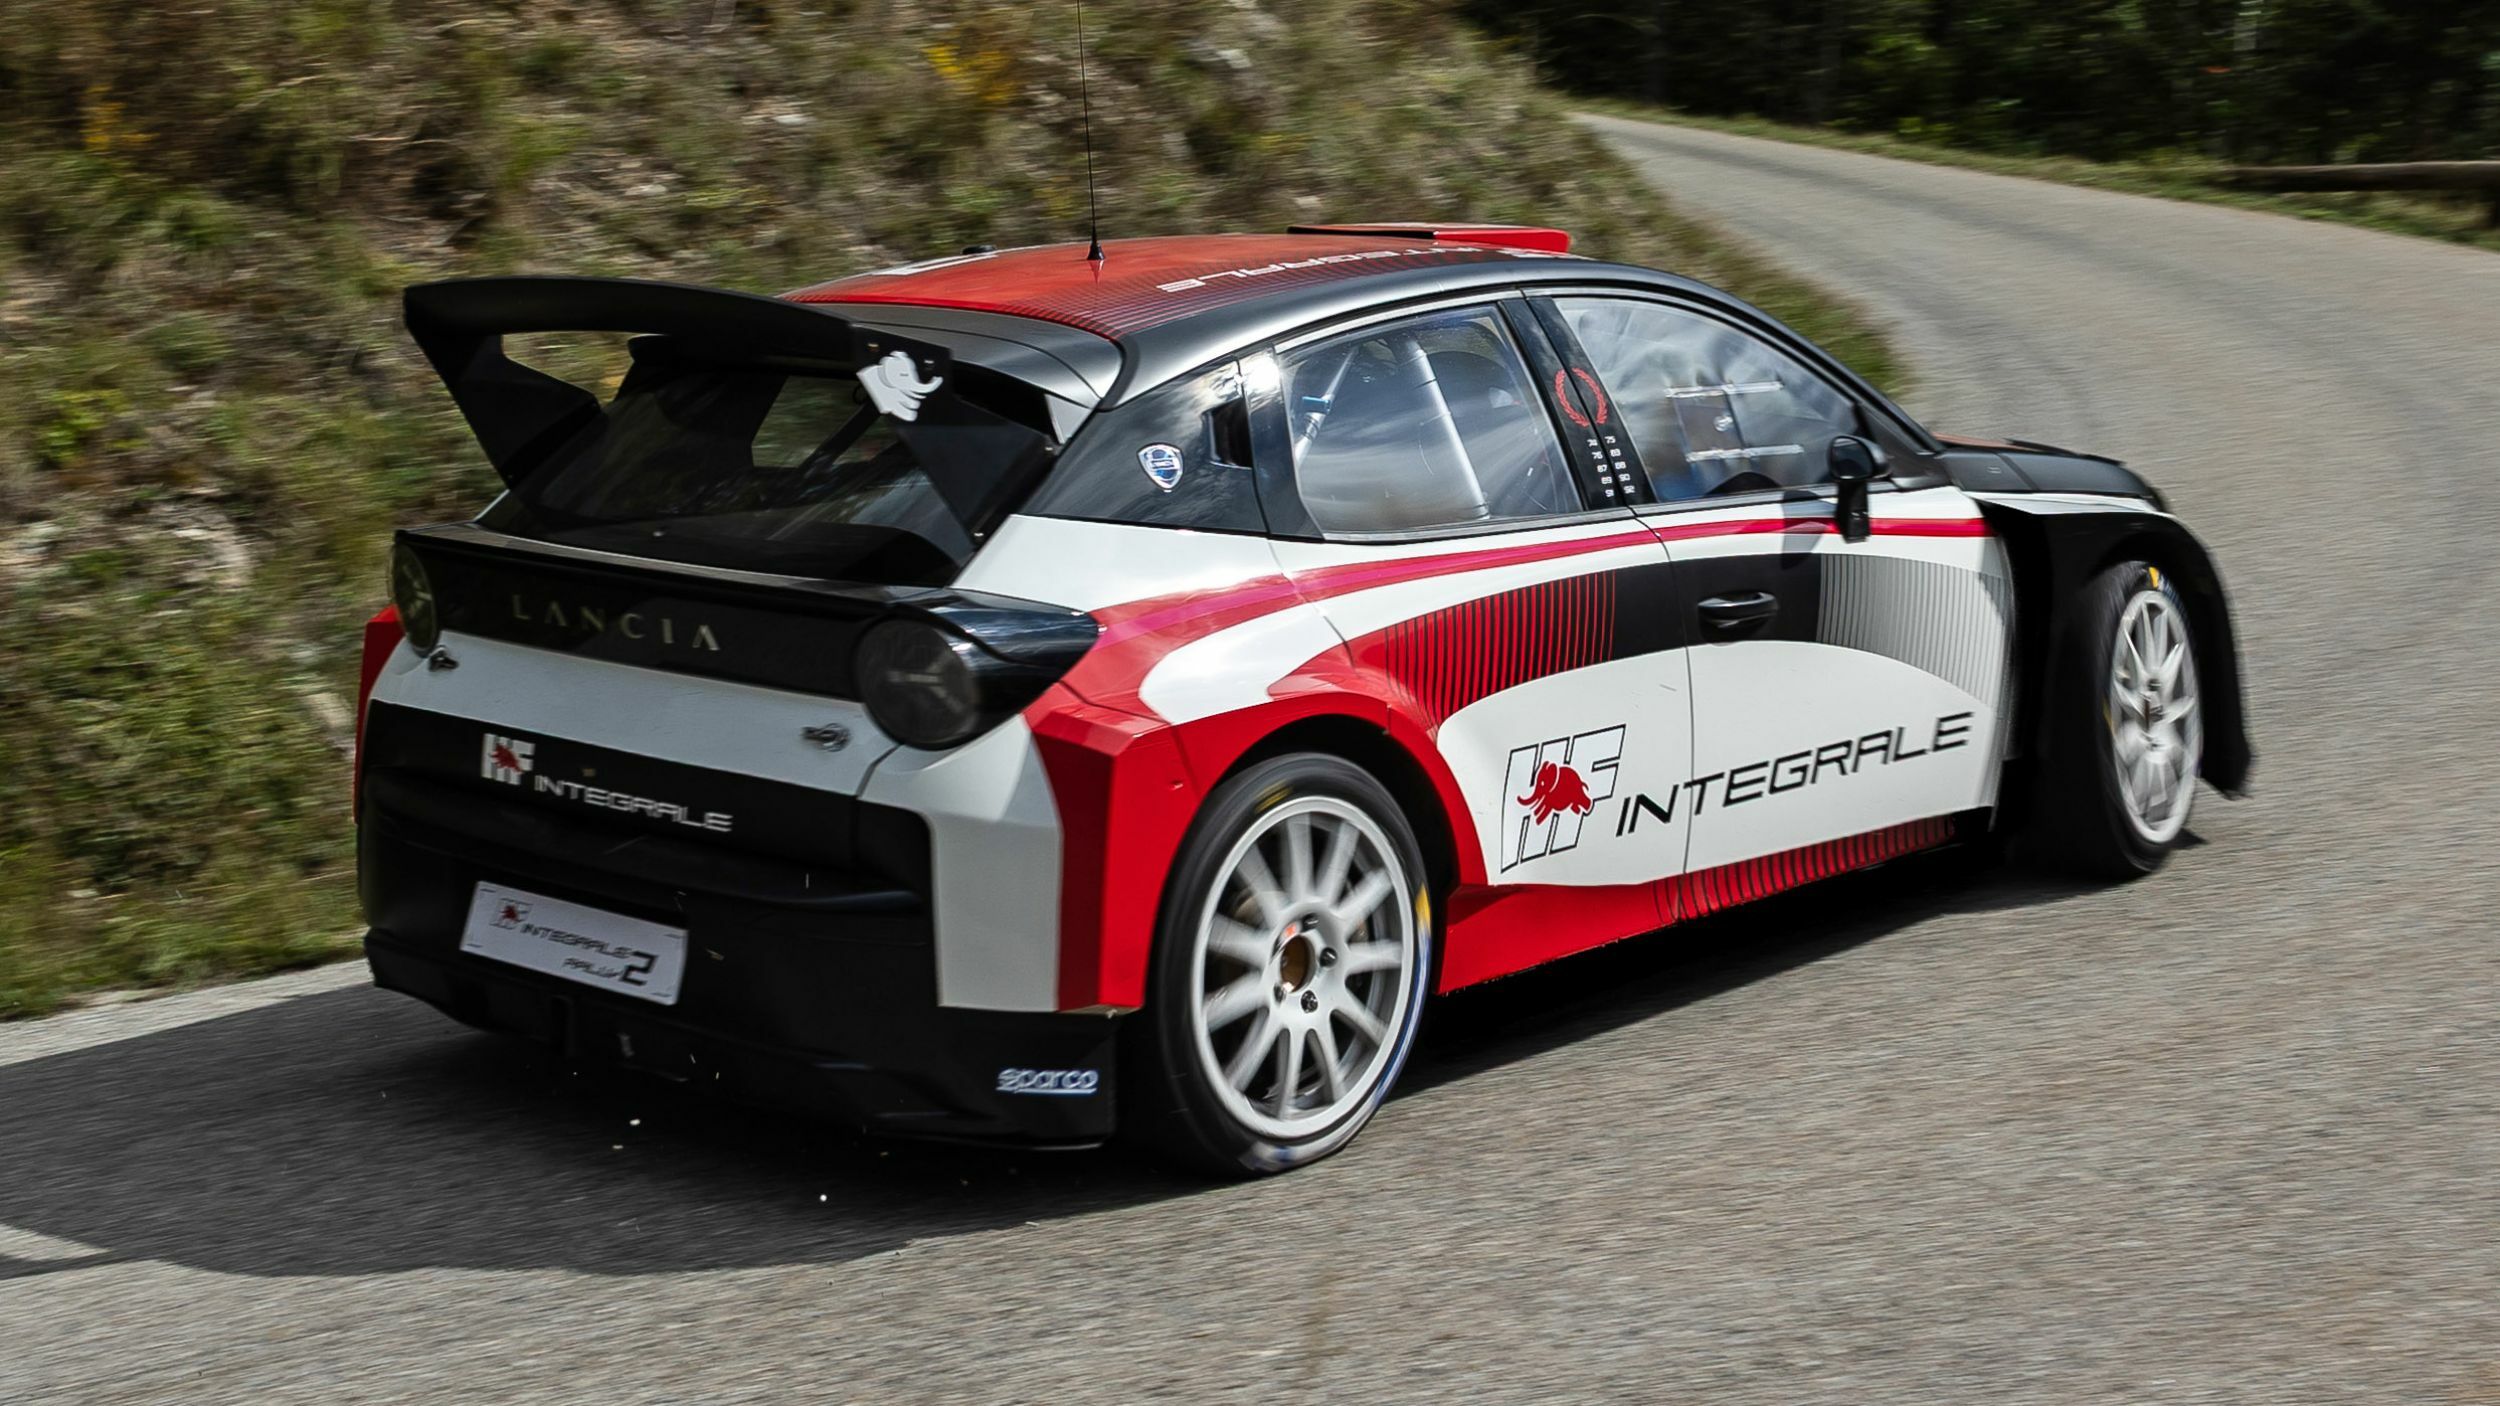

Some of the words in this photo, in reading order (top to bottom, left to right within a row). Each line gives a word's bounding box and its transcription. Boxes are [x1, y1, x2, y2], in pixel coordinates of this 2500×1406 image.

[511, 594, 721, 651] LANCIA
[1615, 711, 1975, 837] INTEGRALE
[534, 774, 734, 832] INTEGRALE
[520, 923, 637, 960] INTEGRALE
[619, 950, 660, 987] 2
[996, 1068, 1099, 1094] sparco
